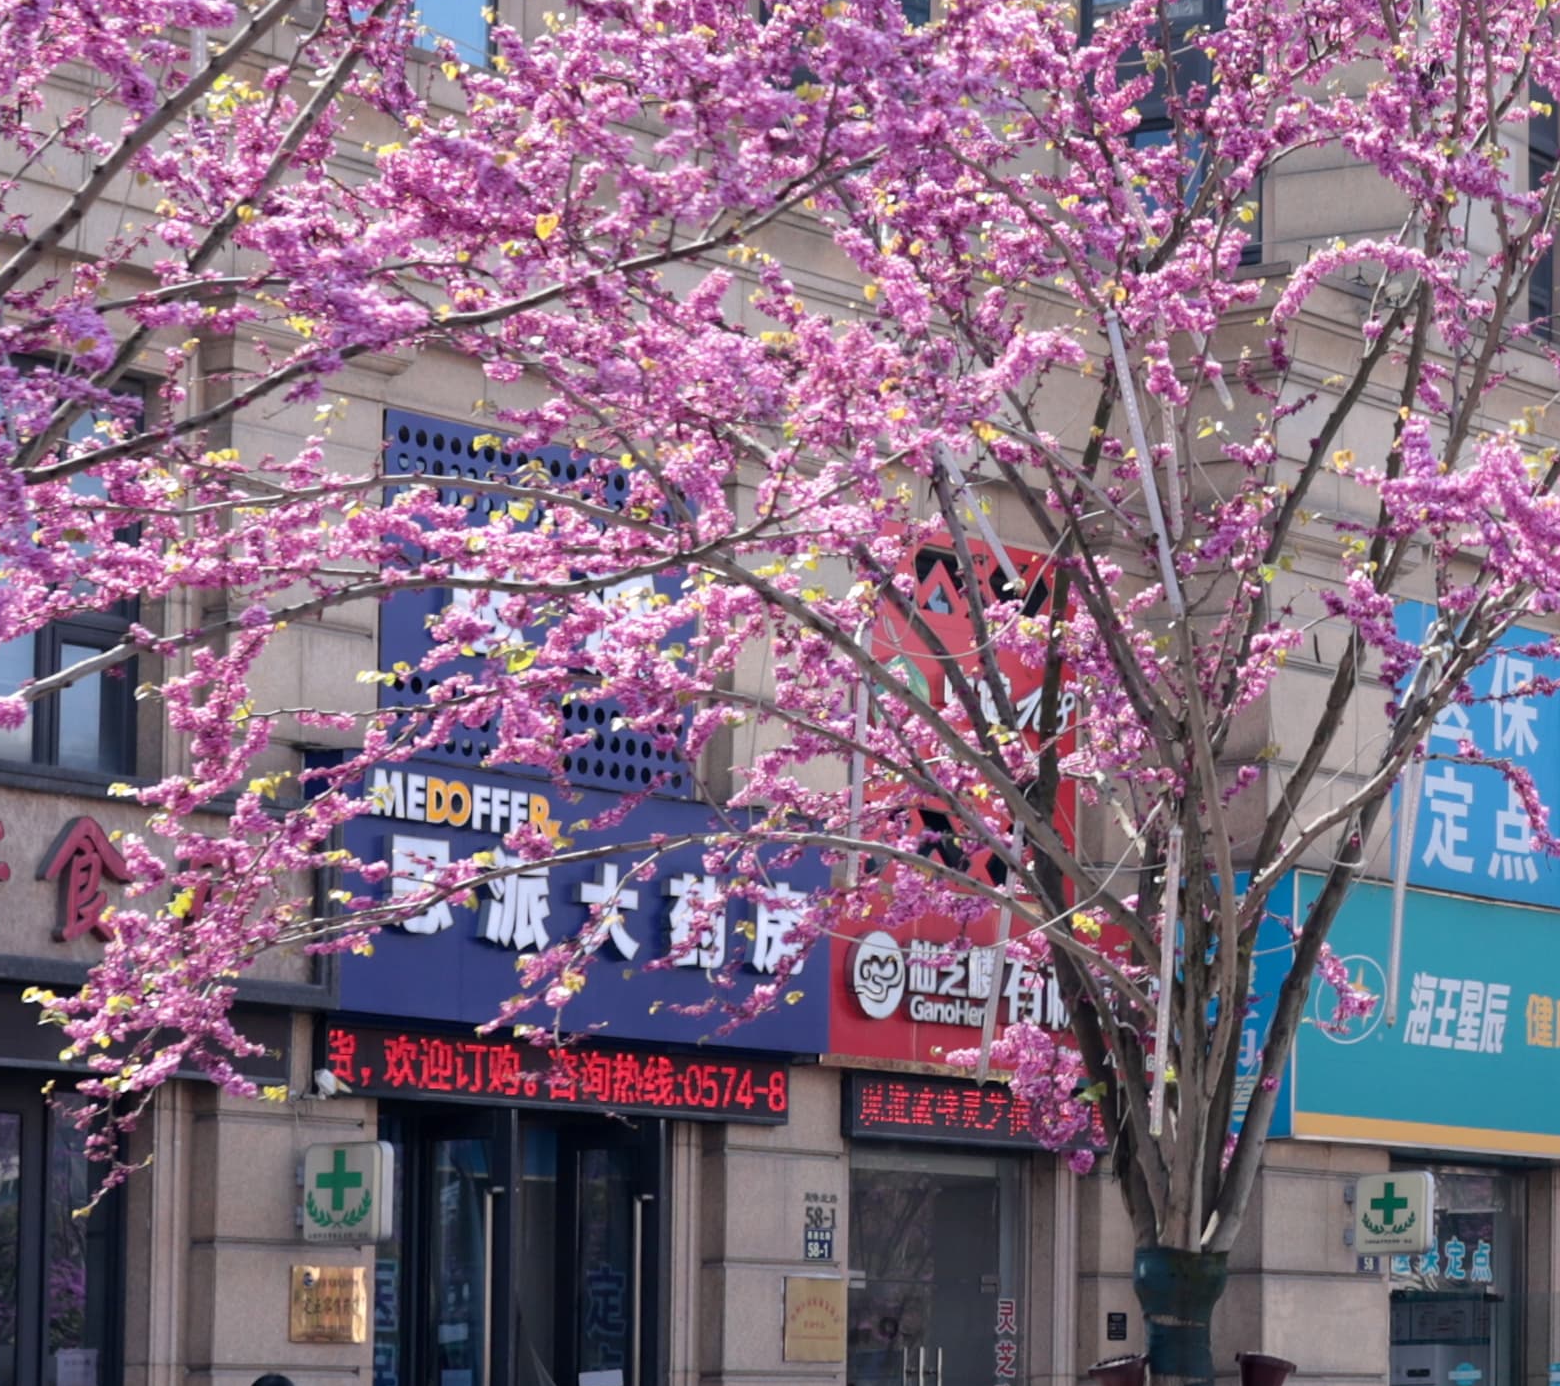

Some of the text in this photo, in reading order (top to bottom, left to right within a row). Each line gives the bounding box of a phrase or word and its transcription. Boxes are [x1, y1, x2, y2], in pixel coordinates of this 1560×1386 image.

[1424, 767, 1539, 884] 定点
[1403, 972, 1512, 1054] 海王星辰
[804, 1206, 837, 1230] 58-1
[807, 1241, 829, 1258] 58-1
